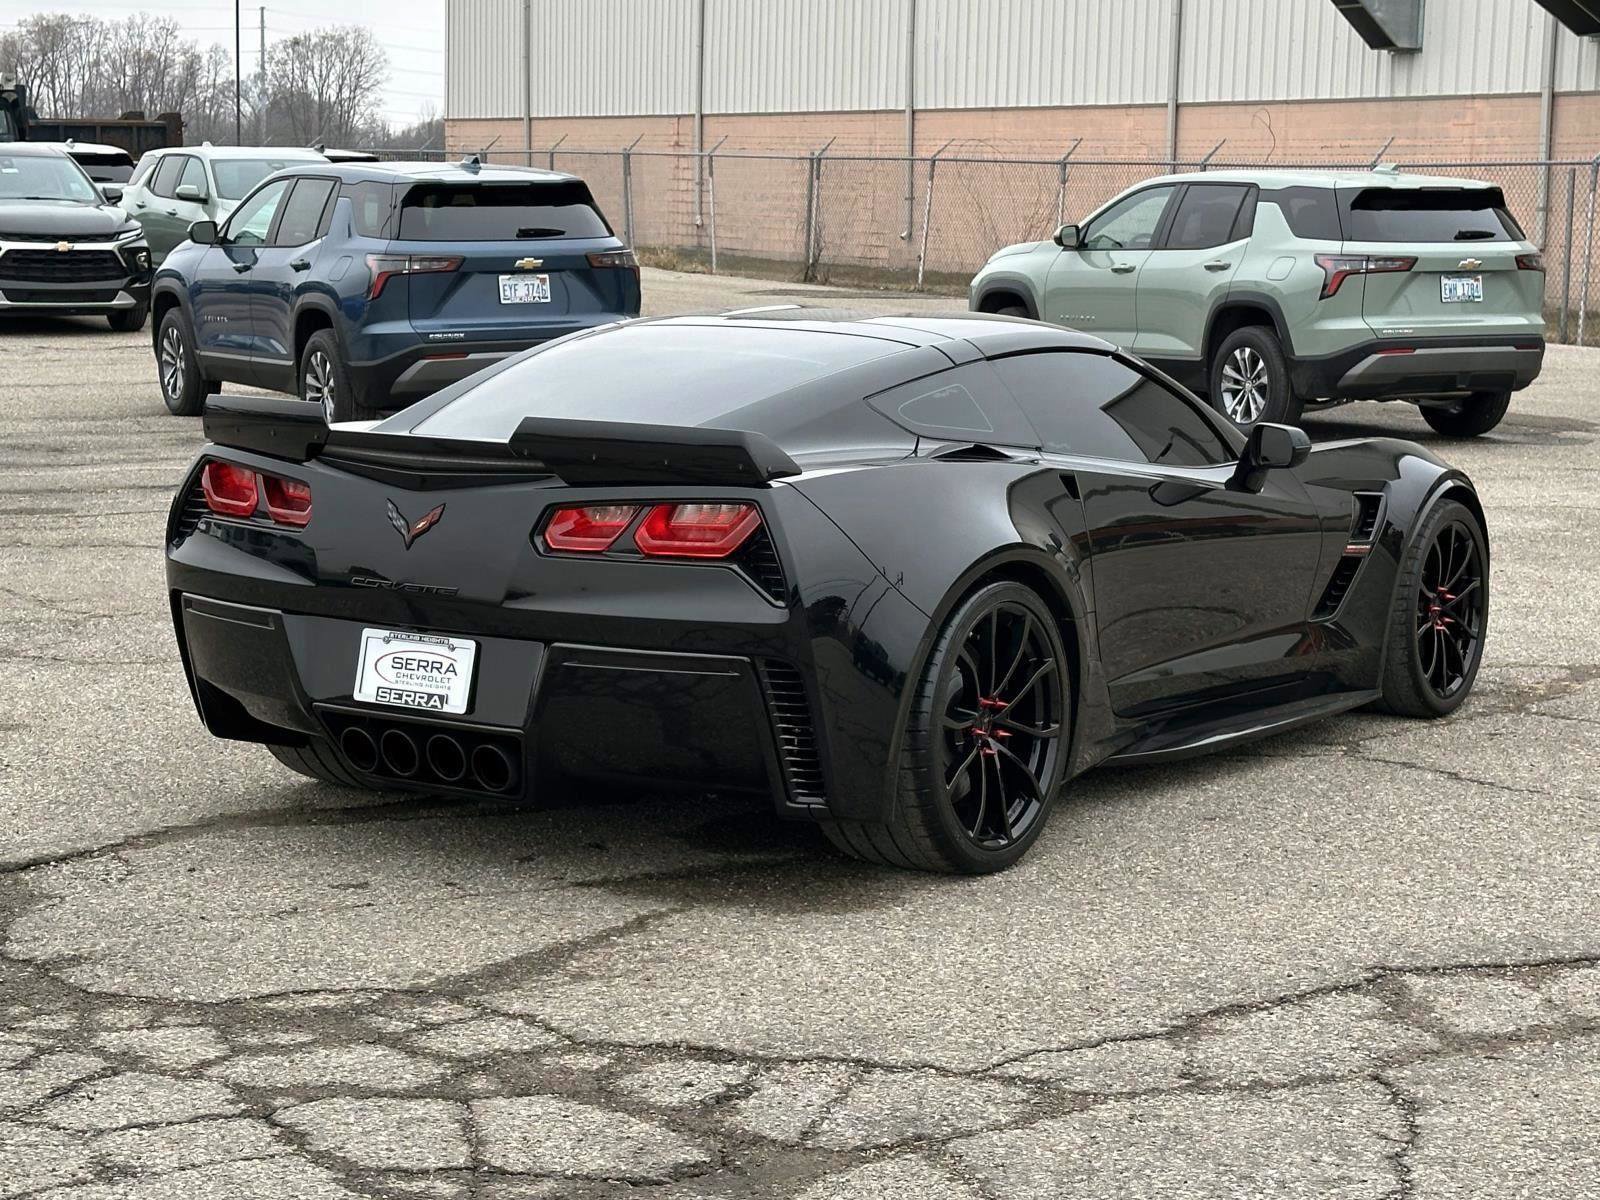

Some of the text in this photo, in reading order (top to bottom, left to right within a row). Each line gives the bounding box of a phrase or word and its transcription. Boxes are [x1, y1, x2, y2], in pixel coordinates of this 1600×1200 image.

[351, 576, 459, 597] CORVETTE
[391, 656, 458, 676] SERRA
[395, 672, 452, 684] CHEVROLET
[377, 688, 442, 709] SERRA
